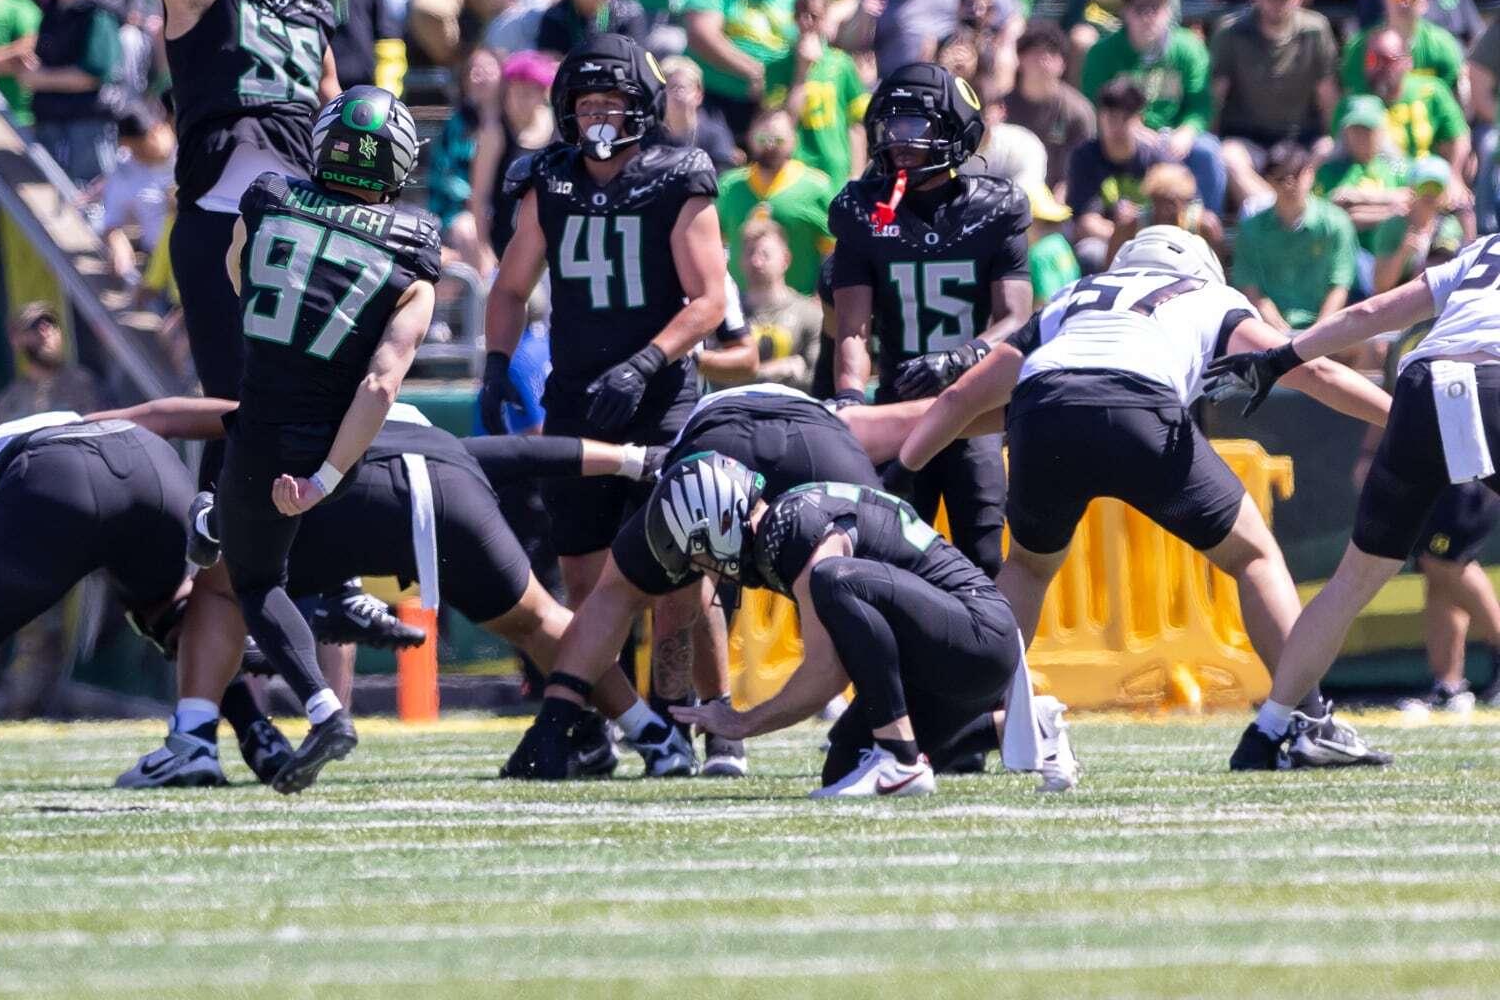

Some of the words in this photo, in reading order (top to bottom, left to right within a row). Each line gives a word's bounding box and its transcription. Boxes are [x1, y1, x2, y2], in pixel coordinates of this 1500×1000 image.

[284, 187, 388, 237] HURYCH
[322, 171, 384, 191] DUCKS
[243, 213, 396, 361] 97
[559, 214, 646, 310] 41
[1060, 271, 1209, 328] 57
[889, 260, 977, 354] 15
